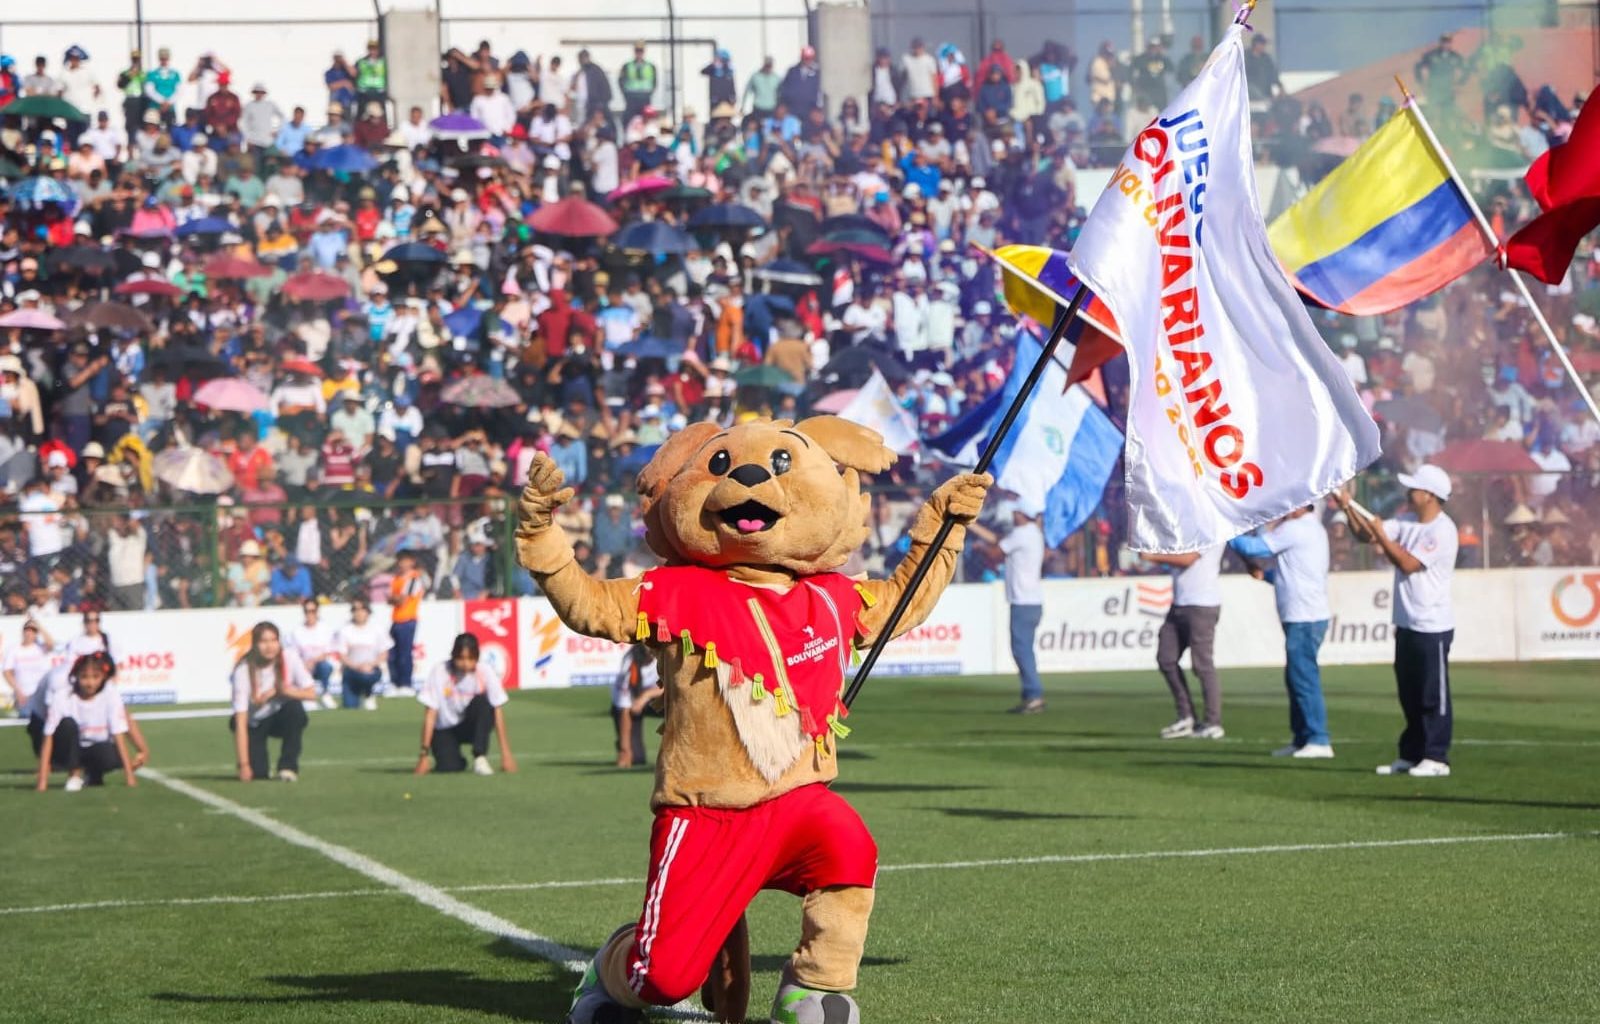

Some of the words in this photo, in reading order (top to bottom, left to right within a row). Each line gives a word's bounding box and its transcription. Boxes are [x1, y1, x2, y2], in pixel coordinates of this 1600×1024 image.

[1134, 117, 1264, 500] OLIVARIANOS
[1103, 587, 1131, 617] el
[1038, 621, 1155, 651] almacé
